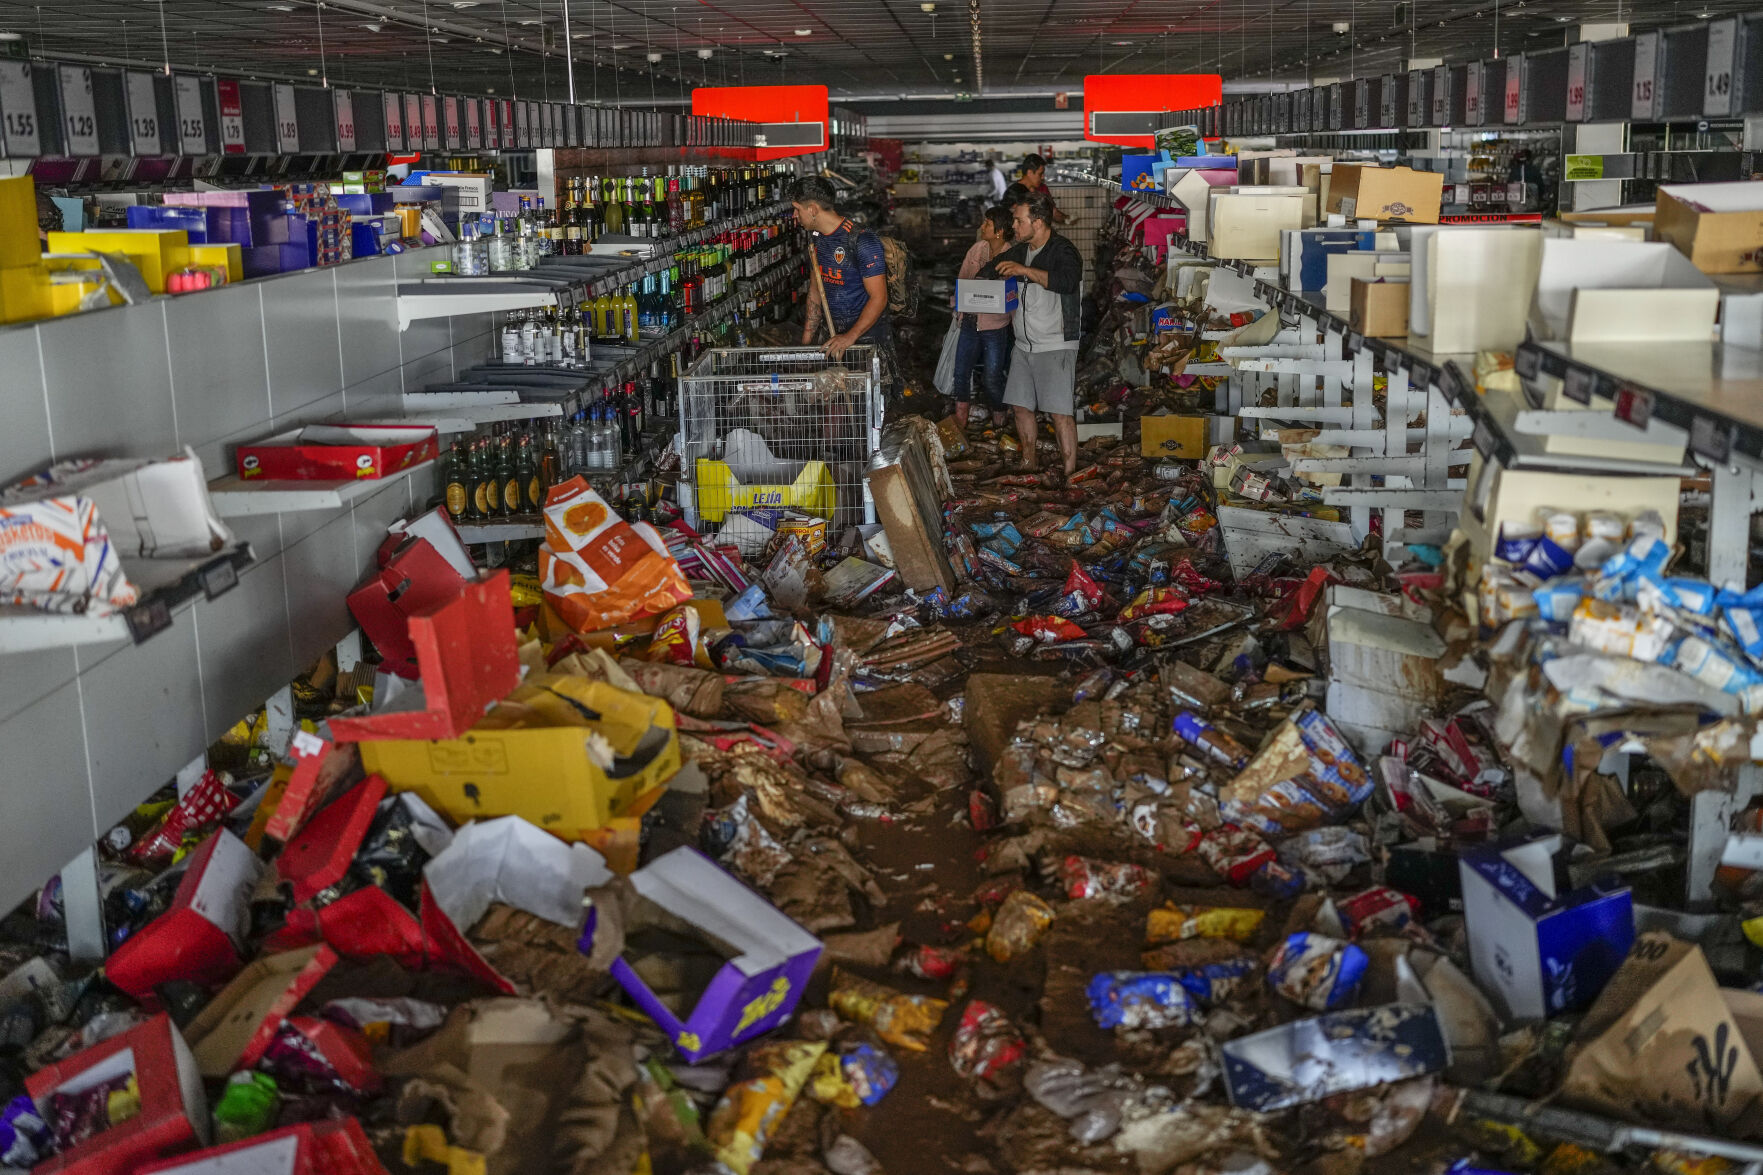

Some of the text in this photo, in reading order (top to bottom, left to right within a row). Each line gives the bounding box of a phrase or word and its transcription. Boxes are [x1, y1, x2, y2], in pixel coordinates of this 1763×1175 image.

[1709, 73, 1729, 96] 1.49
[6, 114, 34, 137] 1.55
[69, 116, 94, 137] 1.29
[134, 118, 156, 138] 1.39
[182, 119, 203, 138] 2.55
[226, 125, 240, 138] 1.79
[281, 122, 296, 138] 1.89
[753, 490, 782, 504] LEJÍA
